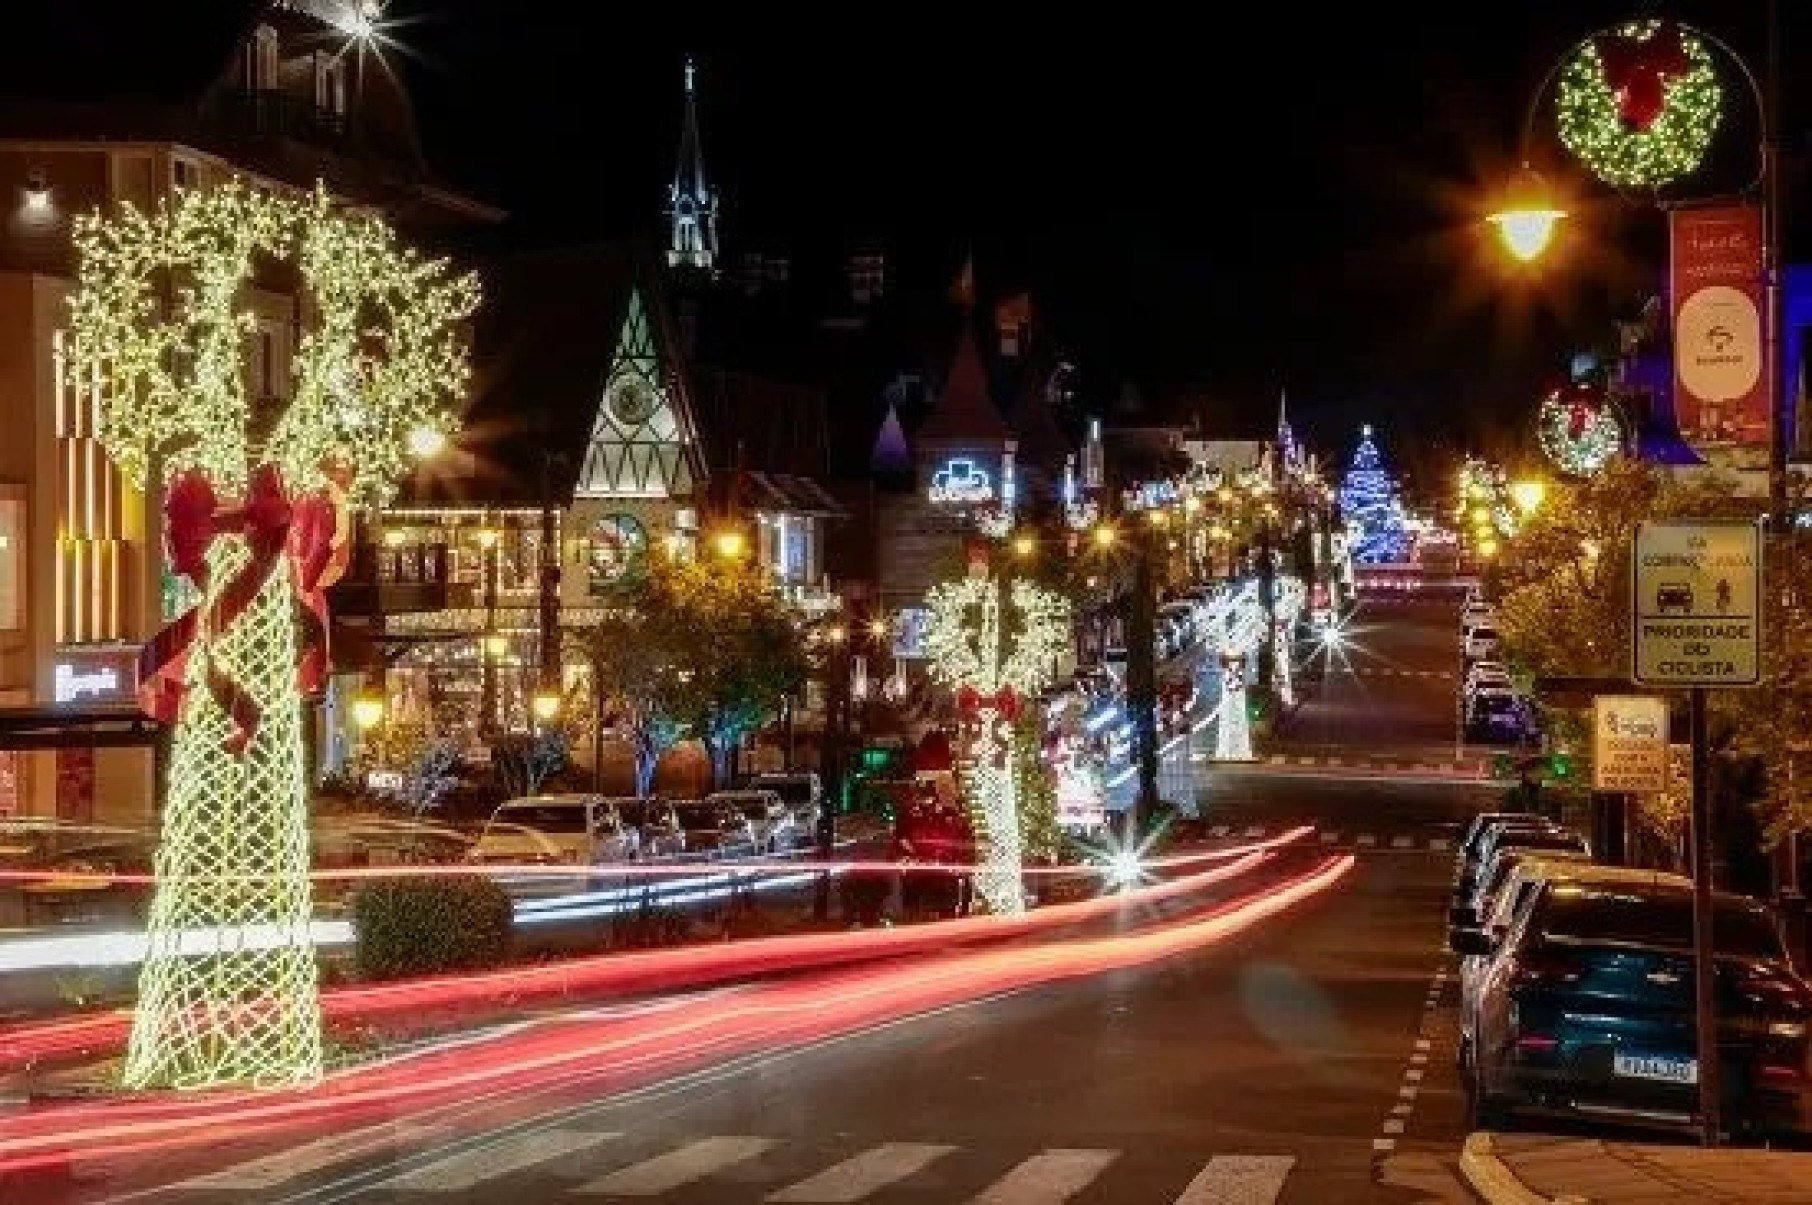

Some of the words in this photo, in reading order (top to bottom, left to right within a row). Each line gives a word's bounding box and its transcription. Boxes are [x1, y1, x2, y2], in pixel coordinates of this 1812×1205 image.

[1643, 625, 1750, 639] PRIORIDADE
[1683, 642, 1710, 655] DO
[1656, 661, 1735, 675] CICLISTA
